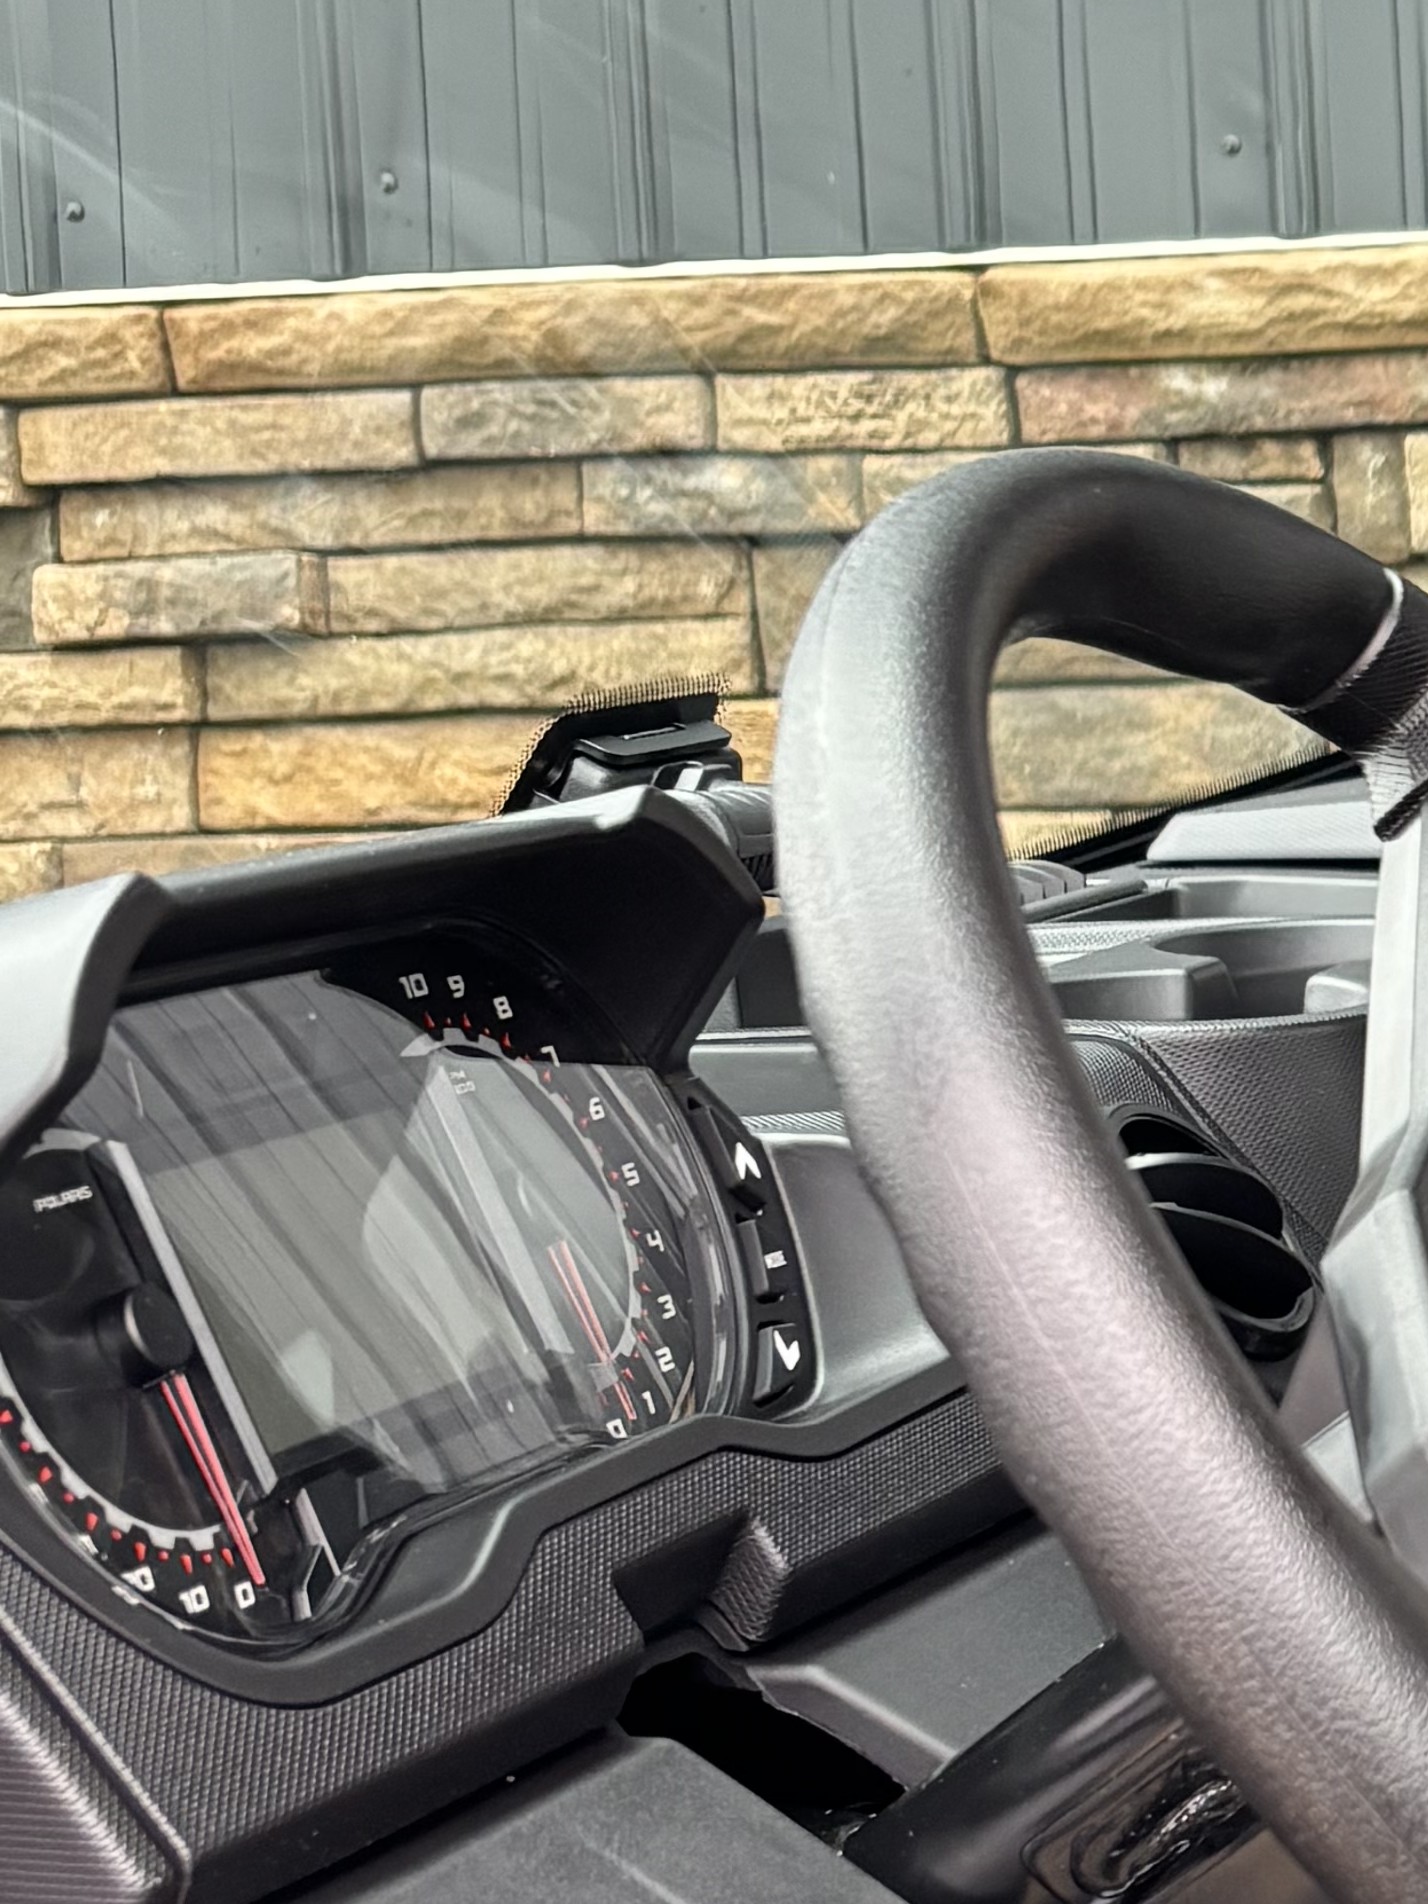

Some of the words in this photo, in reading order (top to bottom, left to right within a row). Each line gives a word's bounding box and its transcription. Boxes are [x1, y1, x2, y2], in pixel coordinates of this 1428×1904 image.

[399, 972, 429, 999] 10
[447, 975, 465, 999] 9
[493, 995, 514, 1020] 8
[541, 1045, 561, 1068] 7
[588, 1097, 605, 1120] 6
[620, 1162, 640, 1187] 5
[645, 1230, 665, 1251] 4
[658, 1298, 677, 1319] 3
[655, 1348, 676, 1373] 2
[641, 1390, 657, 1415] 1
[179, 1585, 210, 1614] 10
[233, 1582, 256, 1609] 0
